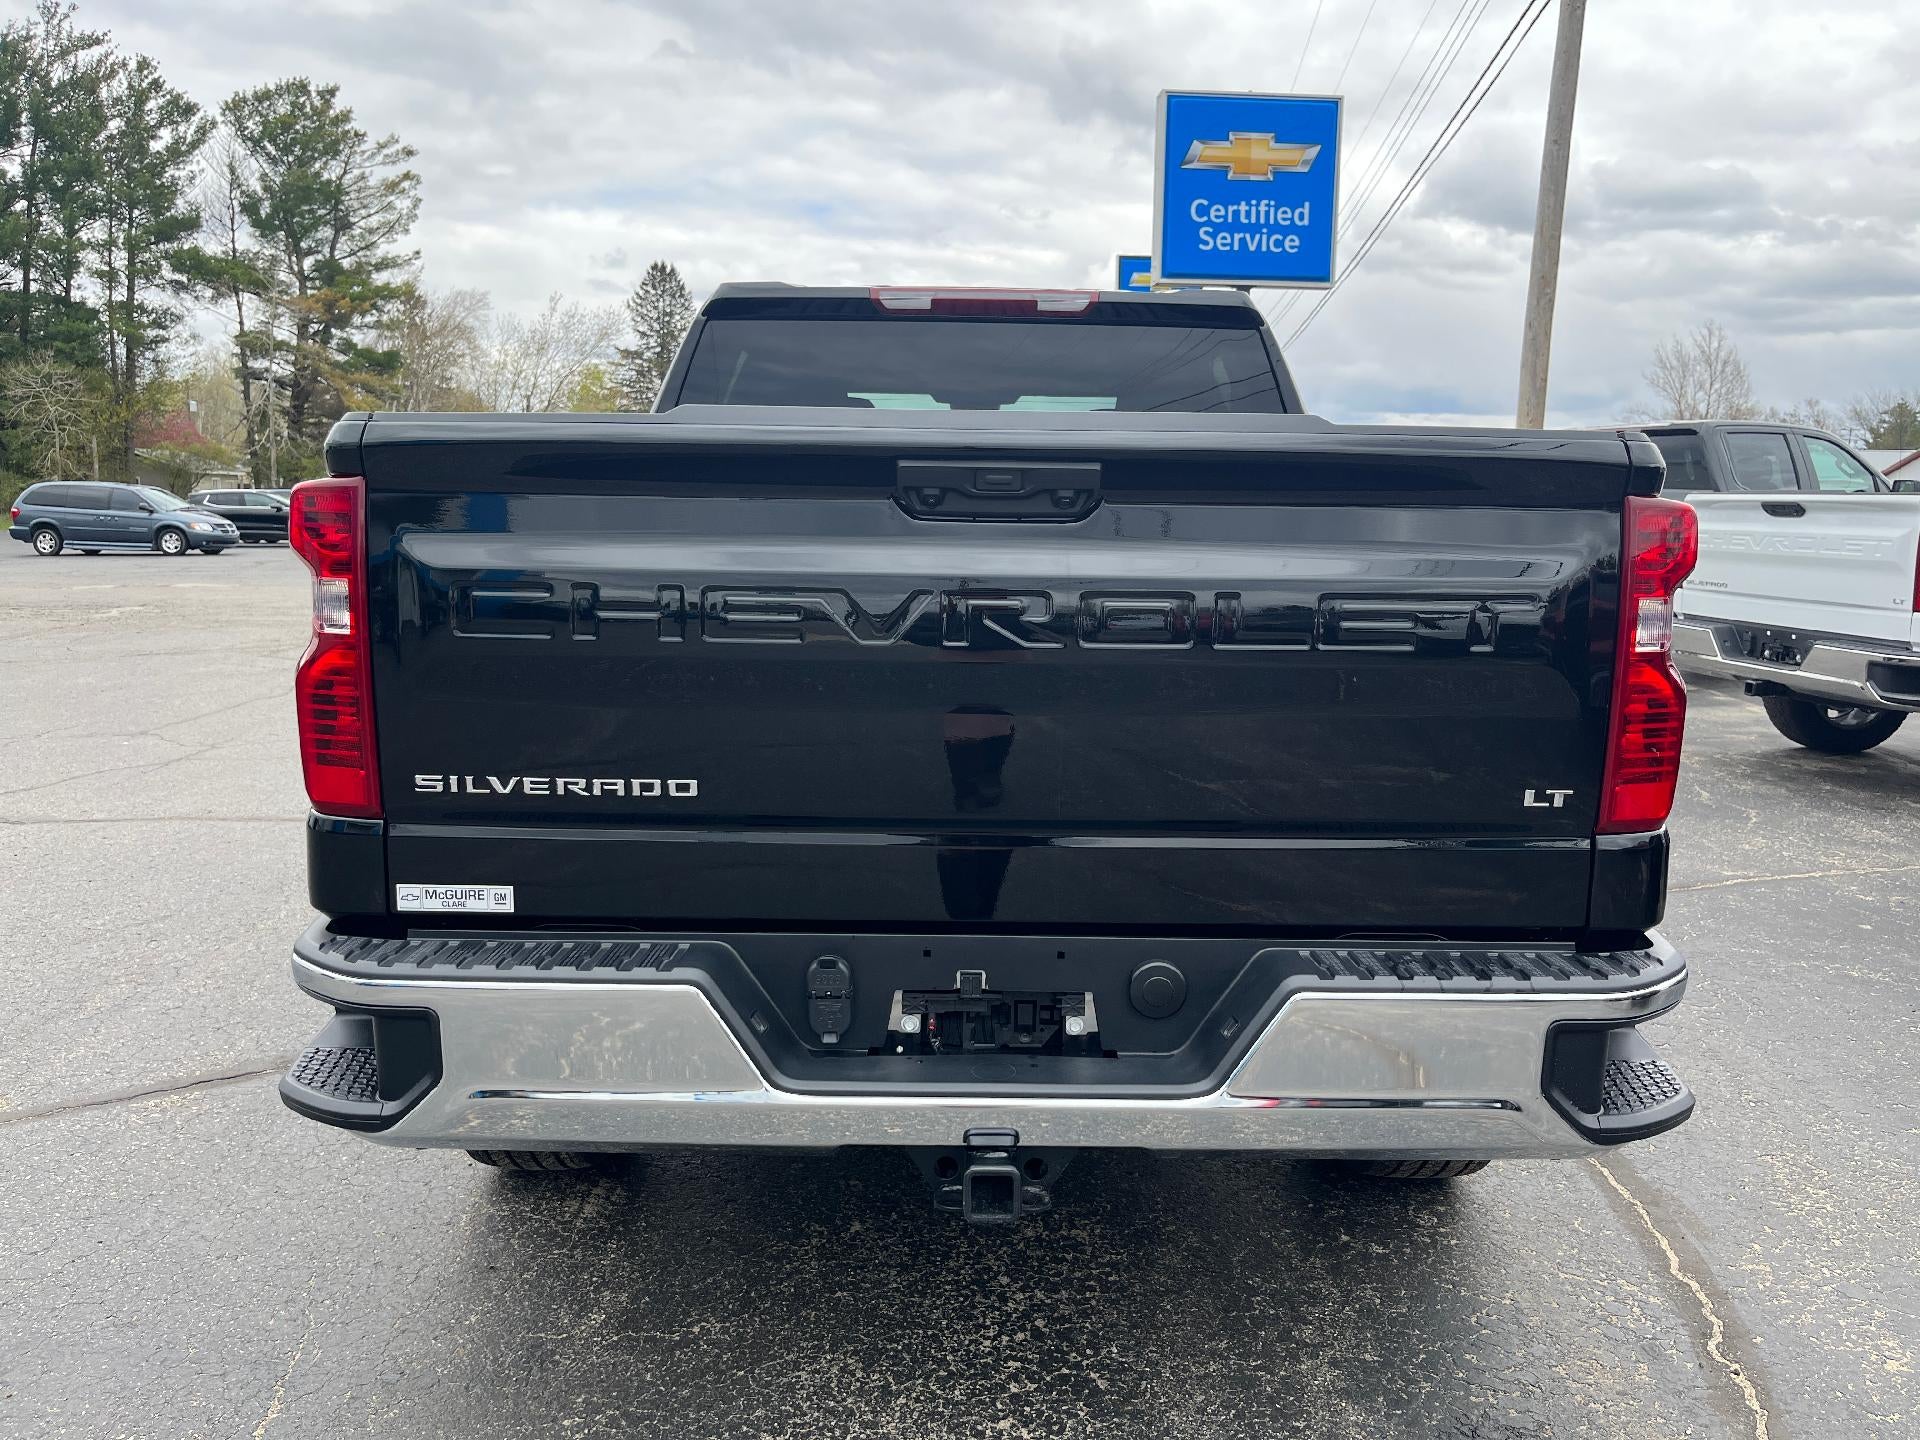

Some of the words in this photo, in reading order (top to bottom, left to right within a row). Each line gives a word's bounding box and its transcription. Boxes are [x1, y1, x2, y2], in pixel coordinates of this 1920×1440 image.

[1190, 198, 1310, 226] Certified
[1198, 226, 1301, 253] Service
[449, 579, 1545, 653] CHEVROLET
[414, 774, 699, 798] SILVERADO
[1523, 789, 1574, 808] LT
[424, 889, 485, 901] McGUIRE
[441, 900, 467, 908] CLARE
[494, 892, 507, 902] GM
